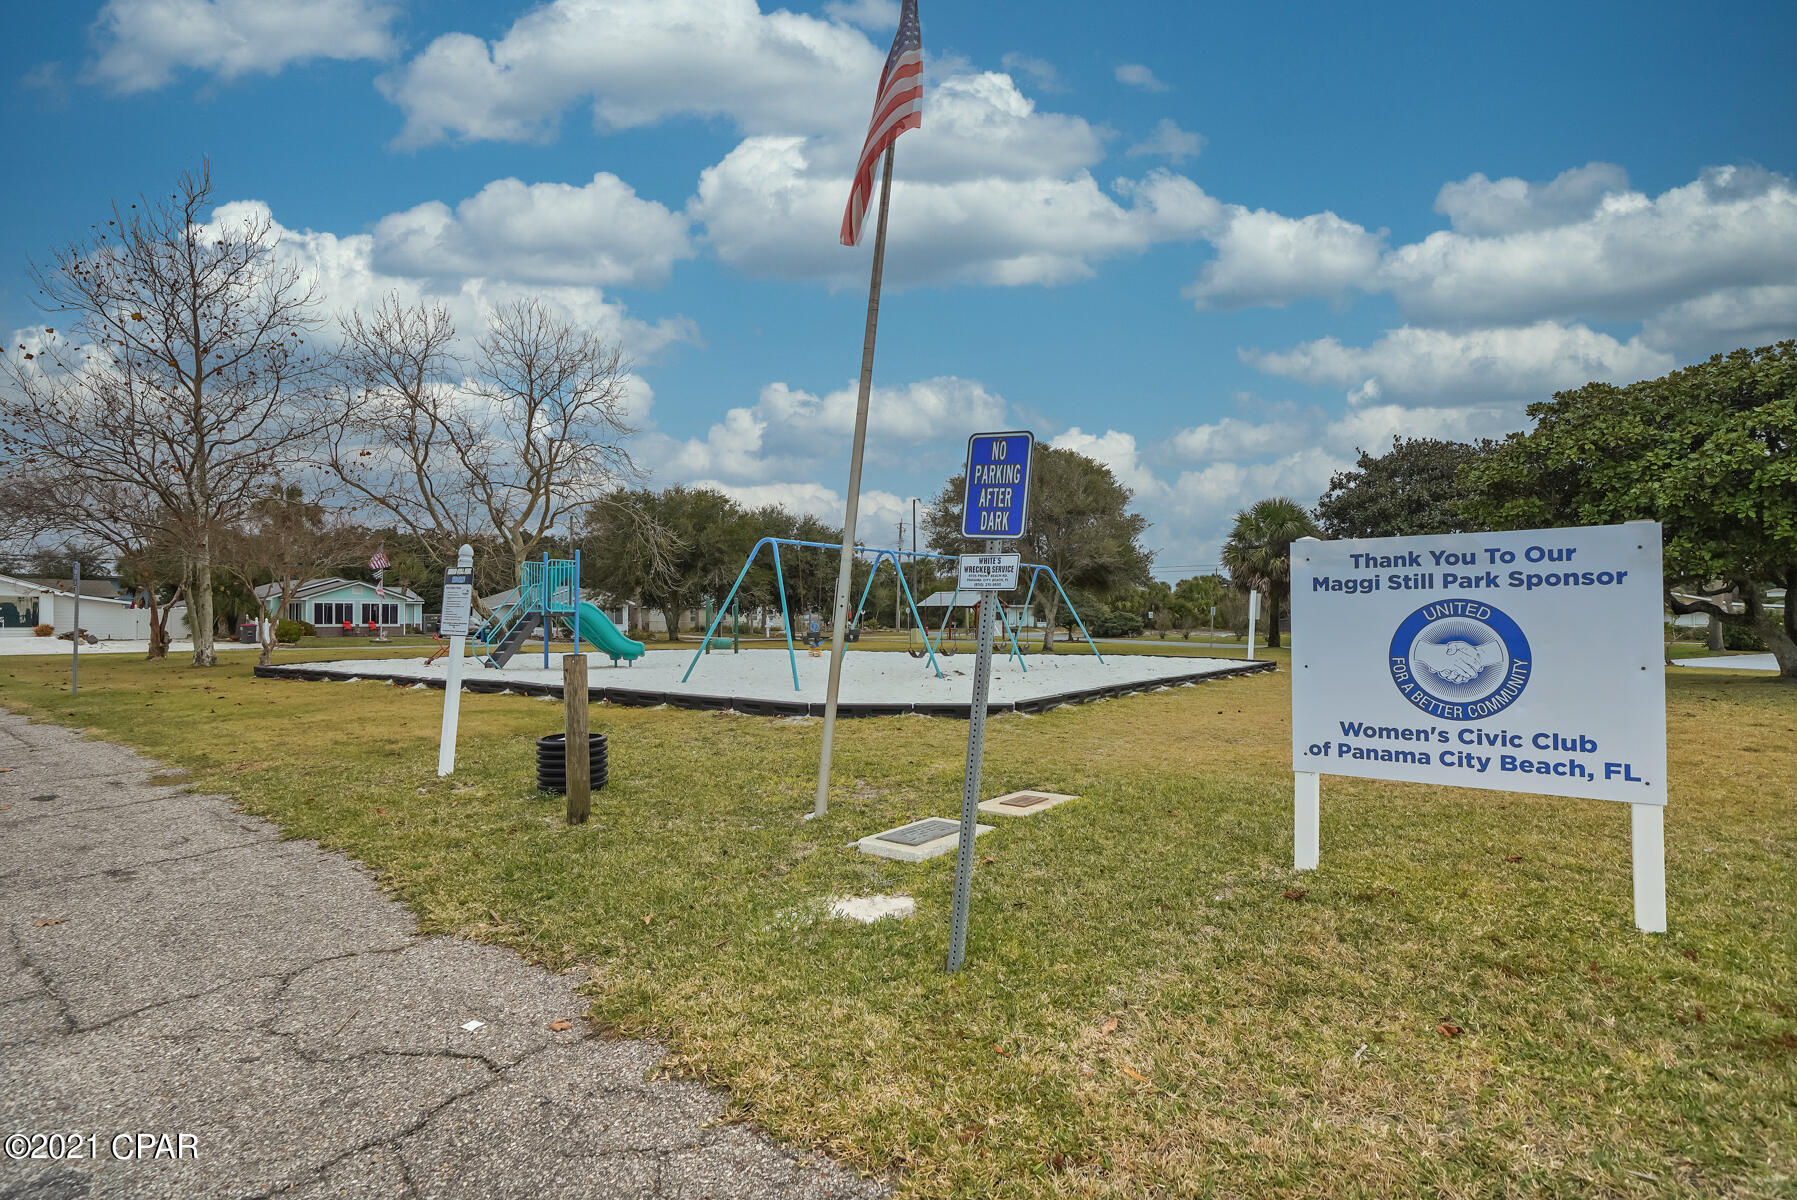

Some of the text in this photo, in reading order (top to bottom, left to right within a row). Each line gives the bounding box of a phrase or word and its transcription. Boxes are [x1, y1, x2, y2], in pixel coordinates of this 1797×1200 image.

[992, 441, 1007, 461] NO
[974, 464, 1022, 484] PARKING
[978, 488, 1013, 508] AFTER
[980, 512, 1010, 531] DARK
[1350, 546, 1577, 569] Thank You To Our
[1312, 570, 1628, 594] Maggi Still Park Sponsor
[1422, 602, 1491, 620] UNITED
[1392, 657, 1528, 718] FOR A BETTER COMMUNITY
[1339, 721, 1598, 753] Women's Civic Club
[1308, 742, 1642, 782] of Panama City Beach, FL
